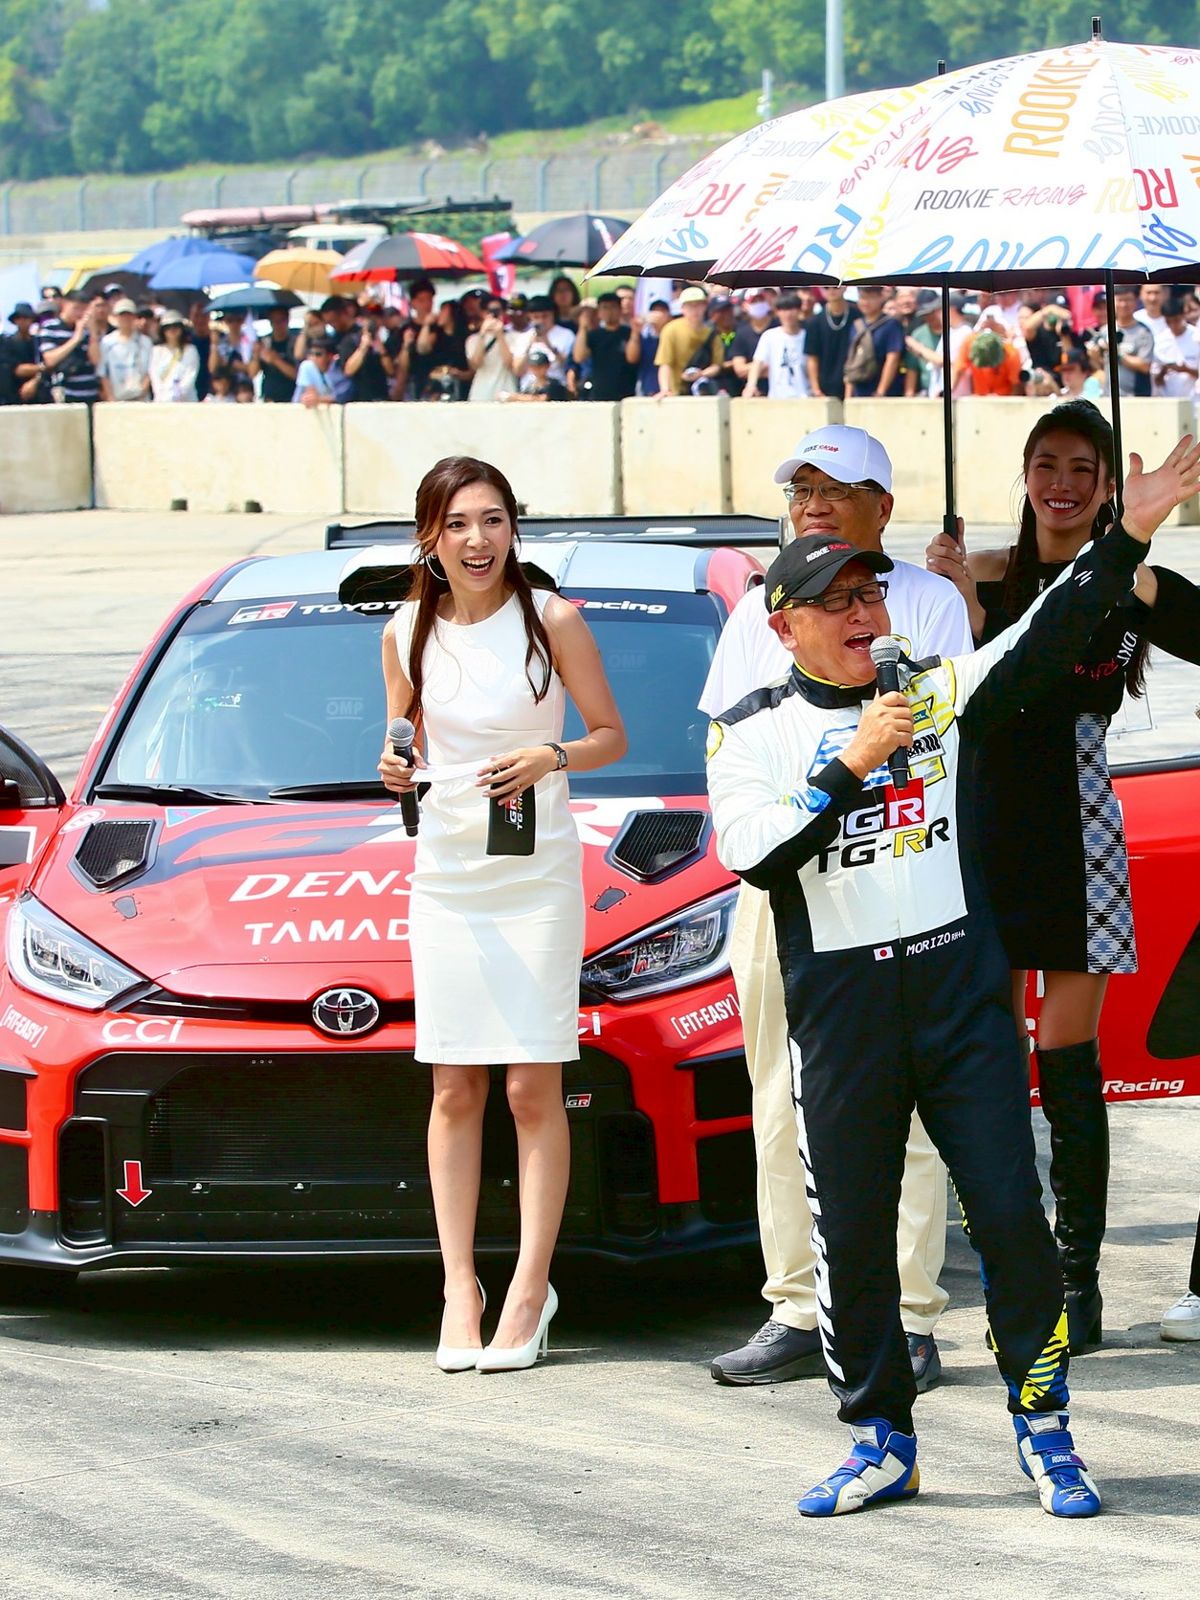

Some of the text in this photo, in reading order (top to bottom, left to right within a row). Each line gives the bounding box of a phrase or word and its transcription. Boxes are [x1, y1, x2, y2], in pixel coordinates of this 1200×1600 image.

[1003, 58, 1101, 158] ROOKIE
[913, 184, 1088, 211] ROOKIE RACING
[299, 601, 408, 617] TOYOT
[325, 700, 364, 717] OMP
[844, 793, 924, 838] GR
[818, 817, 951, 874] TG-RR
[228, 870, 419, 903] DENS
[243, 917, 415, 946] TAMAD
[905, 932, 951, 957] MORIZO
[1102, 1078, 1185, 1094] Racing
[565, 1093, 592, 1109] GR
